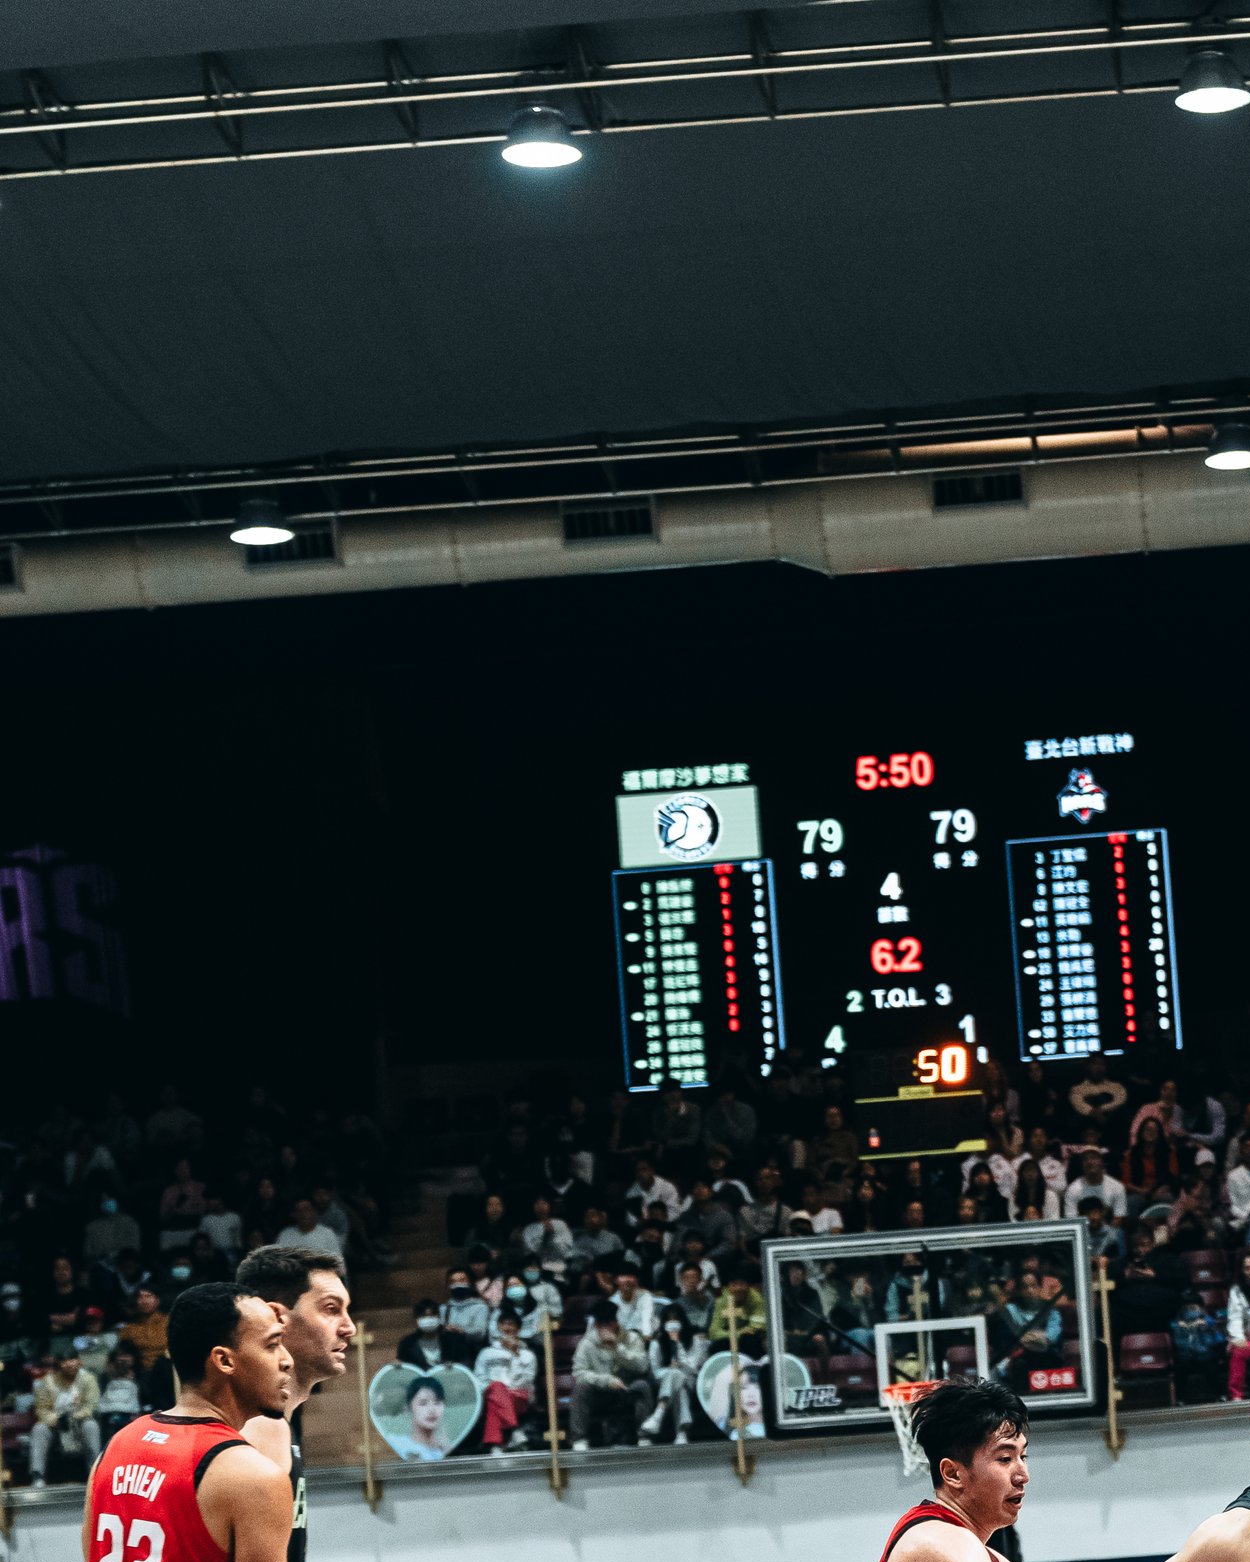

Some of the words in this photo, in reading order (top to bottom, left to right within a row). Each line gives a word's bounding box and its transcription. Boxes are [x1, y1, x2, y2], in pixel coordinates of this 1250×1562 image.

[855, 751, 934, 790] 5:50
[797, 818, 844, 854] 79
[929, 808, 977, 844] 79
[880, 872, 903, 900] 4
[846, 989, 864, 1012] 2
[935, 983, 952, 1006] 3
[824, 1025, 847, 1053] 4
[958, 1014, 976, 1043] 1
[112, 1464, 166, 1502] CHIEN
